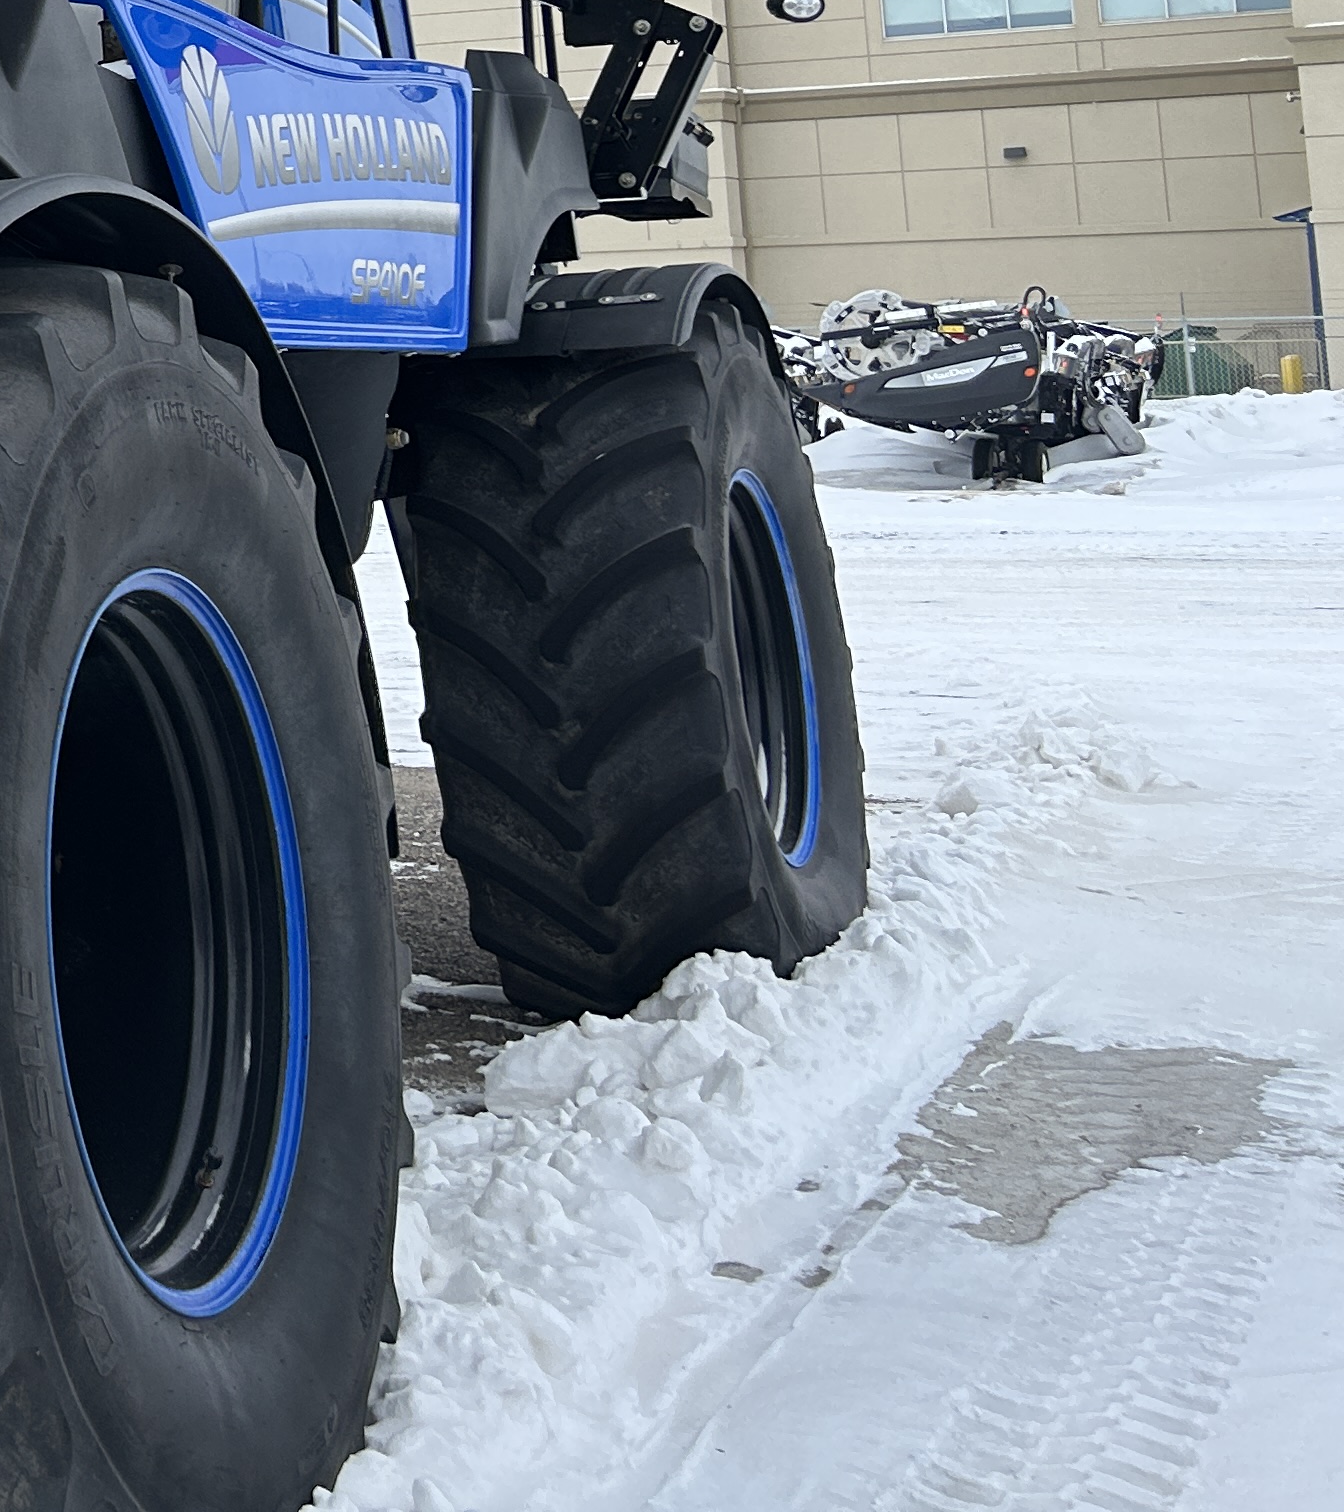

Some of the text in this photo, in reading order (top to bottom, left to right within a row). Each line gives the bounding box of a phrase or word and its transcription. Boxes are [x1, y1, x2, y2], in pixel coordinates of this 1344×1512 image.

[246, 113, 452, 188] NEW HOLLAND
[351, 258, 426, 307] SP410F
